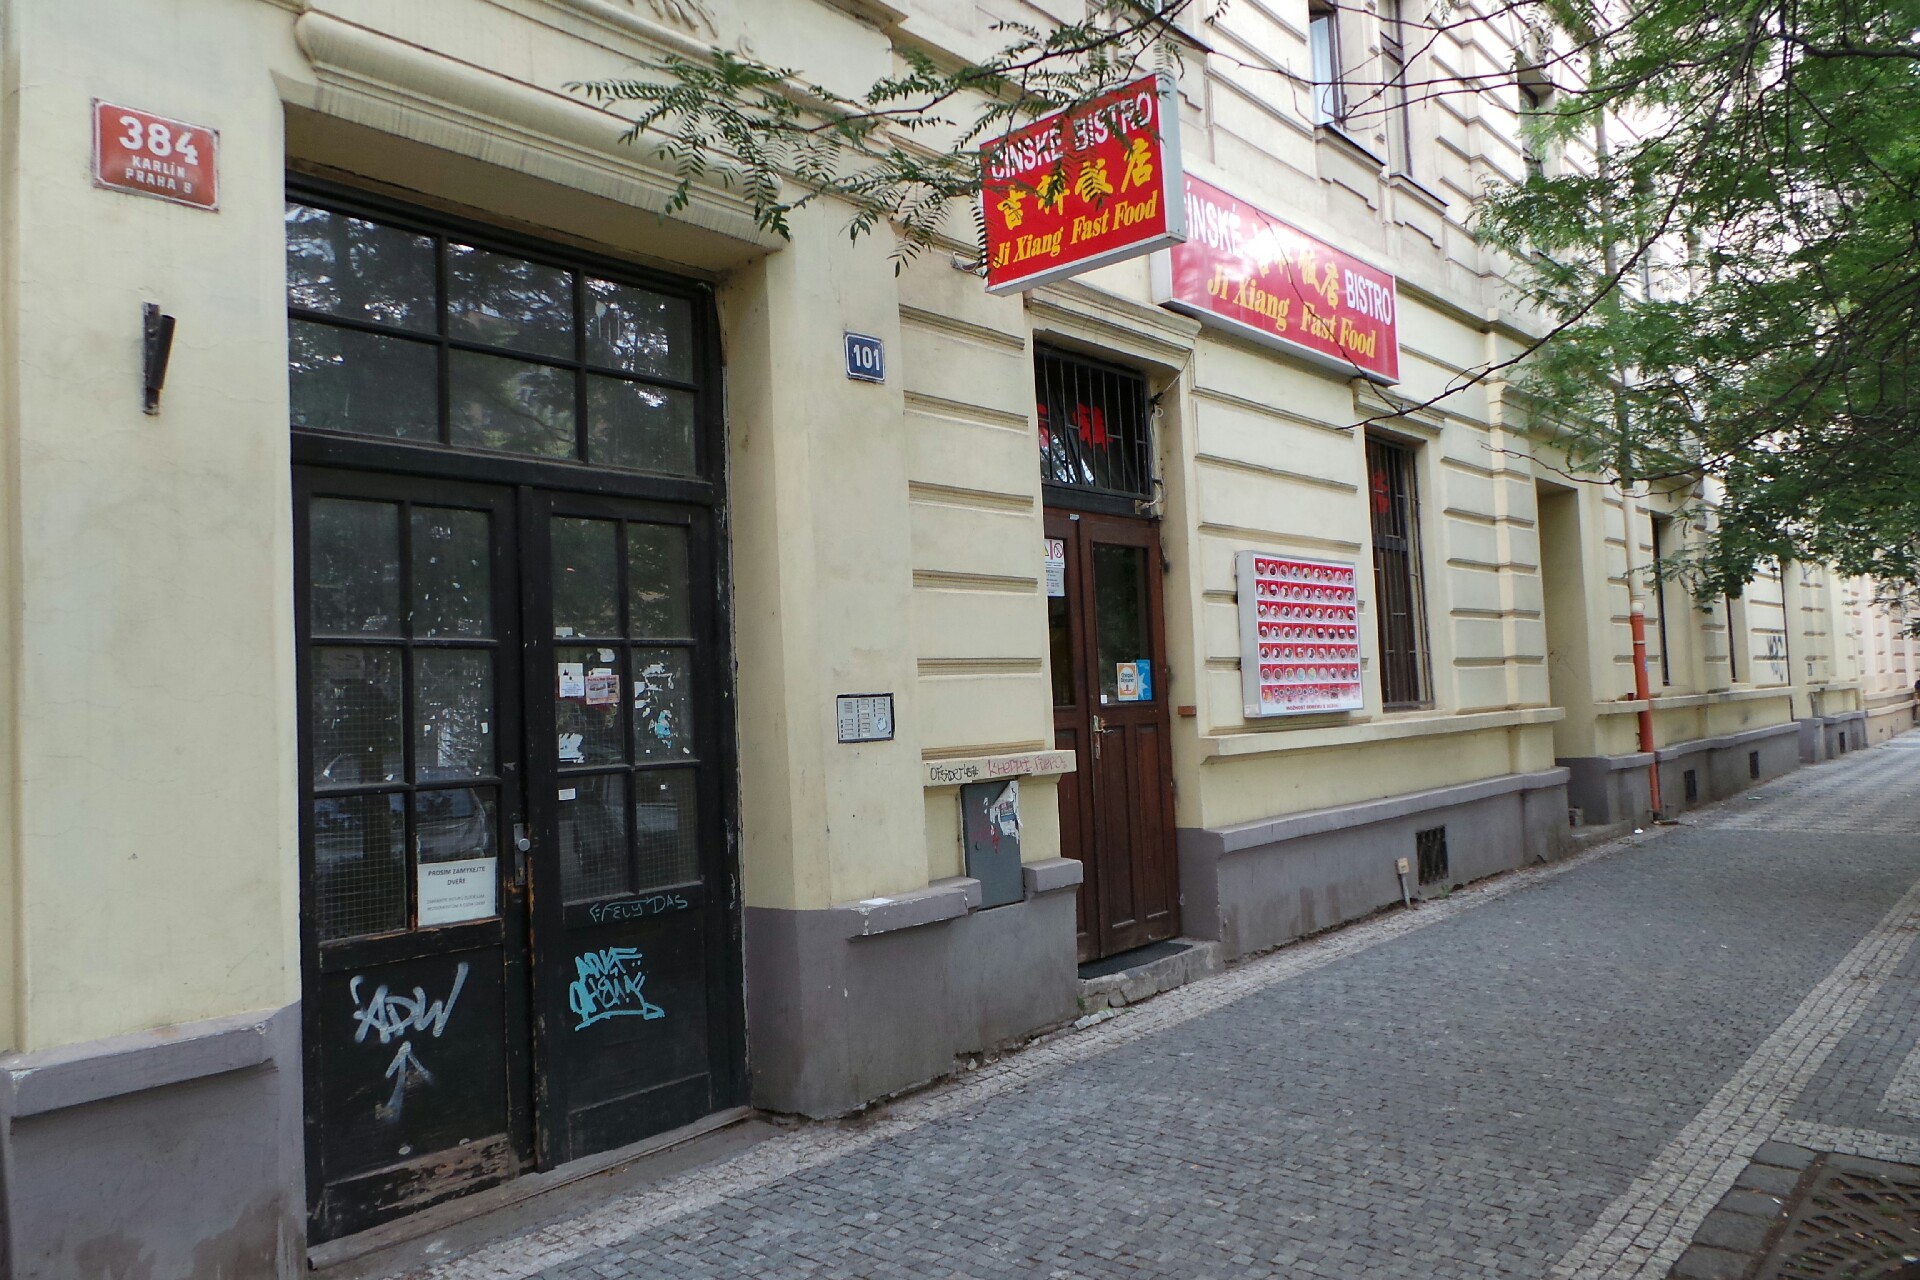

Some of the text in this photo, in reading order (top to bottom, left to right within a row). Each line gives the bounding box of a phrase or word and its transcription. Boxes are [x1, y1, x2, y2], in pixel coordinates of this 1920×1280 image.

[118, 115, 199, 166] 384
[1073, 91, 1153, 150] BISTRO
[125, 167, 193, 194] PRAHA 8
[132, 154, 186, 178] KARLÍN
[992, 190, 1159, 269] Ji Xiang Fast Food
[1183, 180, 1393, 326] ÍNSKÉ BISTRO
[1207, 262, 1377, 359] Ji Xiang Fast Food
[853, 344, 880, 371] 101
